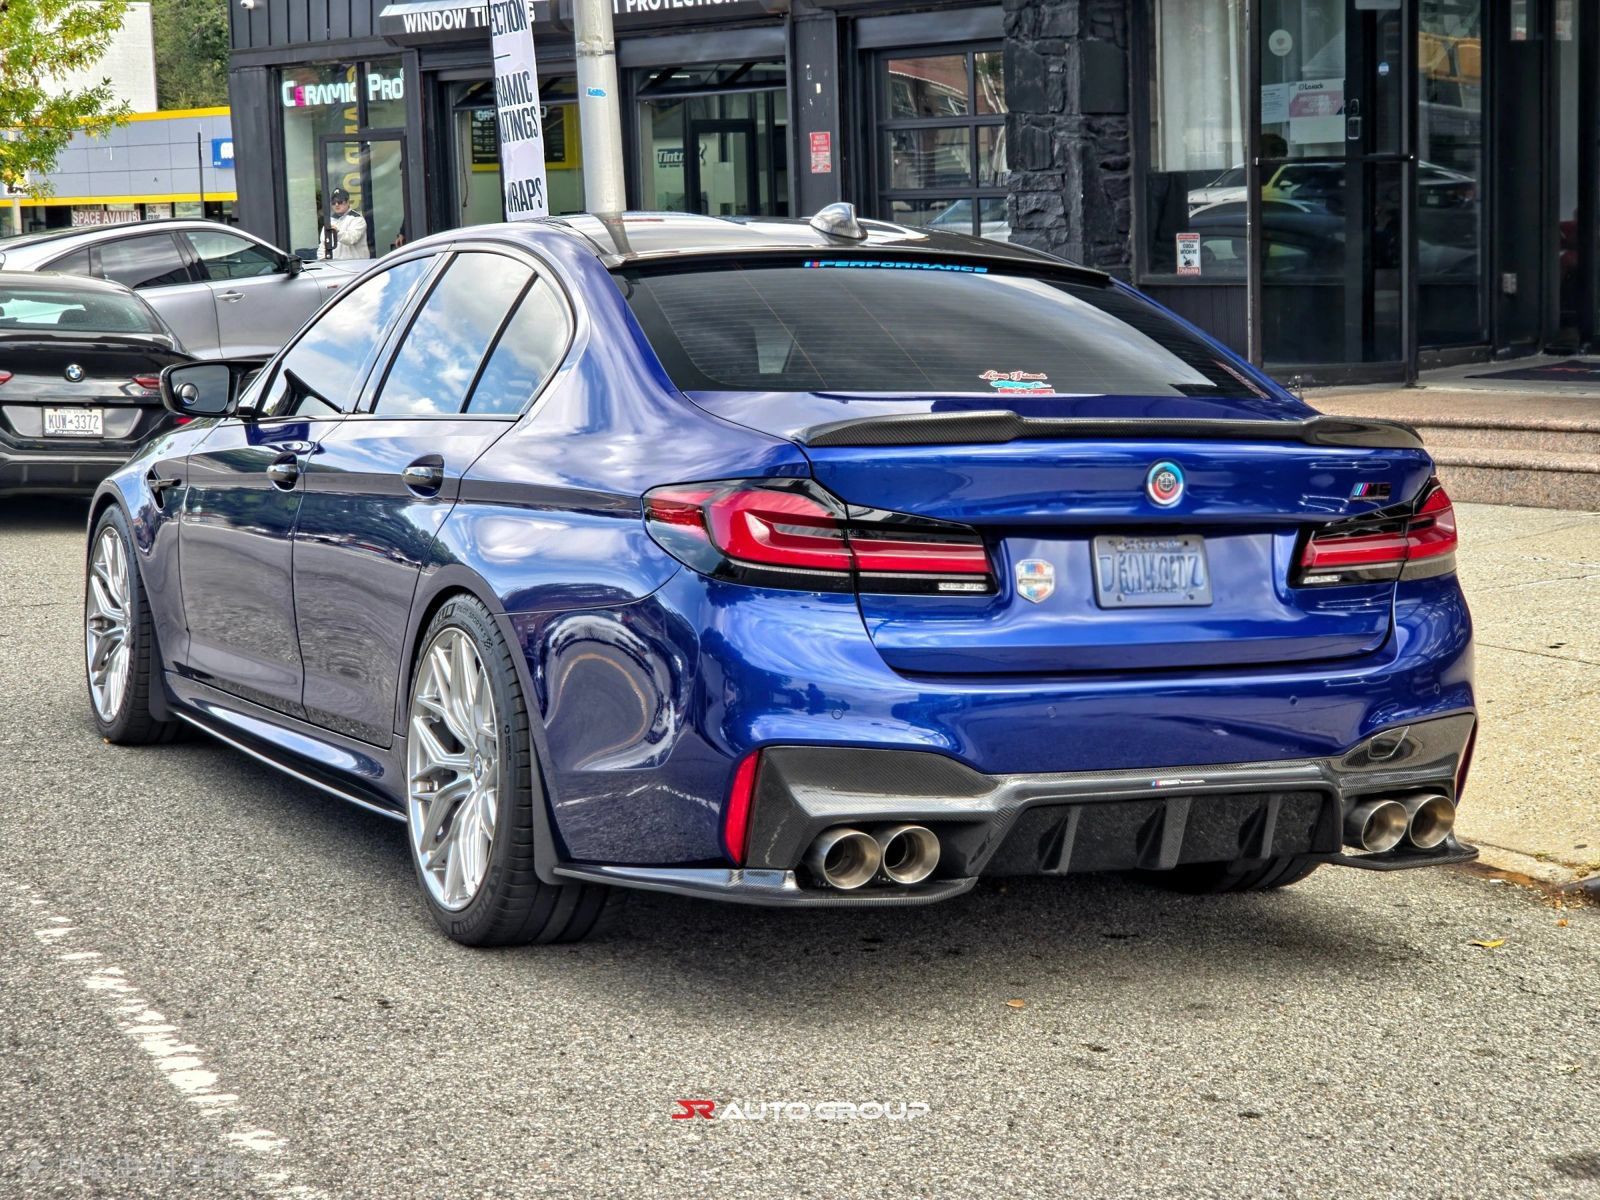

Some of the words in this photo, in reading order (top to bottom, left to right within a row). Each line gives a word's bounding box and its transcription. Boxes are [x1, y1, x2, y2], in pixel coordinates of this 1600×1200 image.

[403, 9, 467, 33] WINDOW
[72, 211, 100, 225] SPACE
[819, 261, 988, 273] PERFORMANCE
[74, 414, 99, 430] 3372
